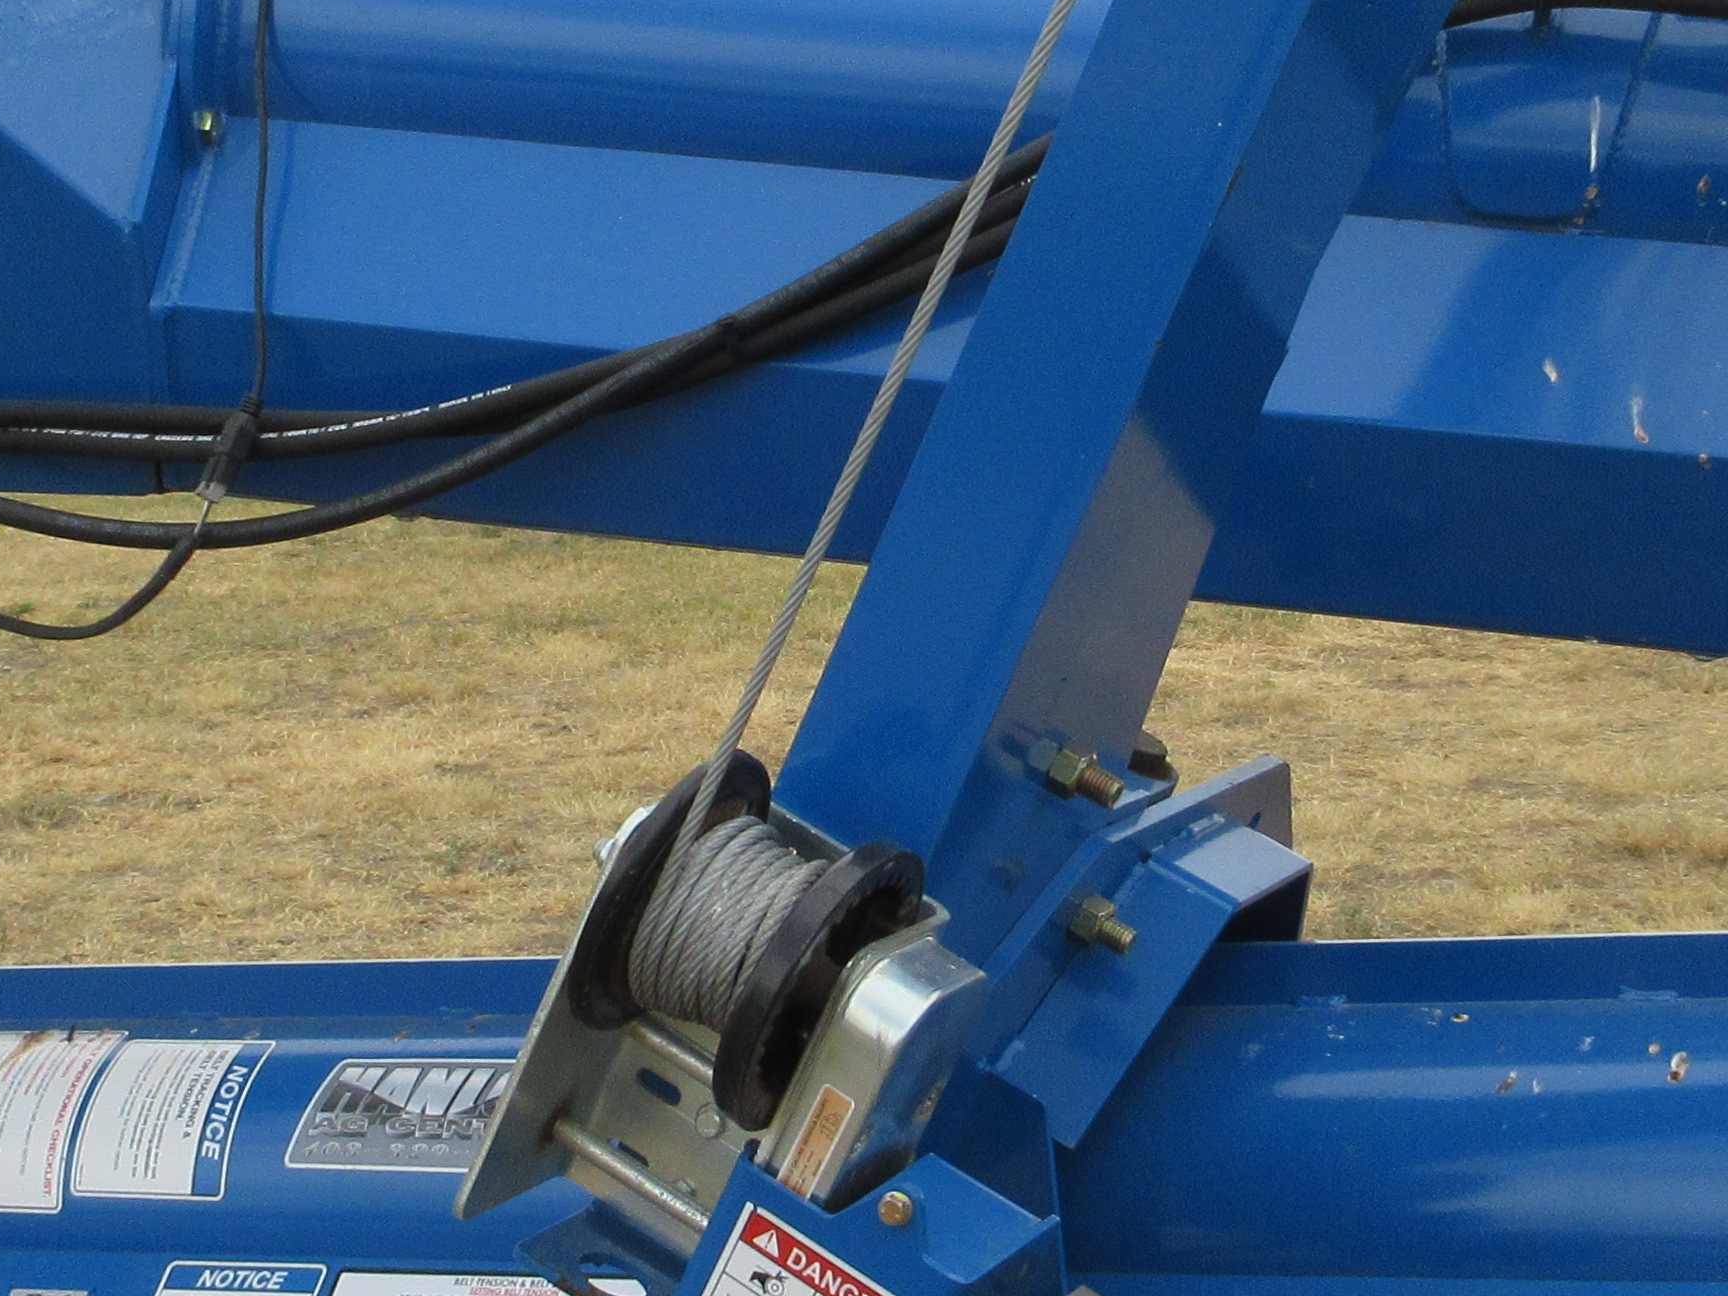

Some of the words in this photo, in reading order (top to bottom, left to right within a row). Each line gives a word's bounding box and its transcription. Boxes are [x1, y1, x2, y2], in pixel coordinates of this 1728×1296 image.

[185, 1071, 215, 1128] TRACKING
[201, 1065, 250, 1160] NOTICE
[308, 1114, 369, 1137] AG
[195, 1269, 289, 1289] NOTICE
[454, 1278, 475, 1287] BELT
[476, 1278, 517, 1287] TENSION
